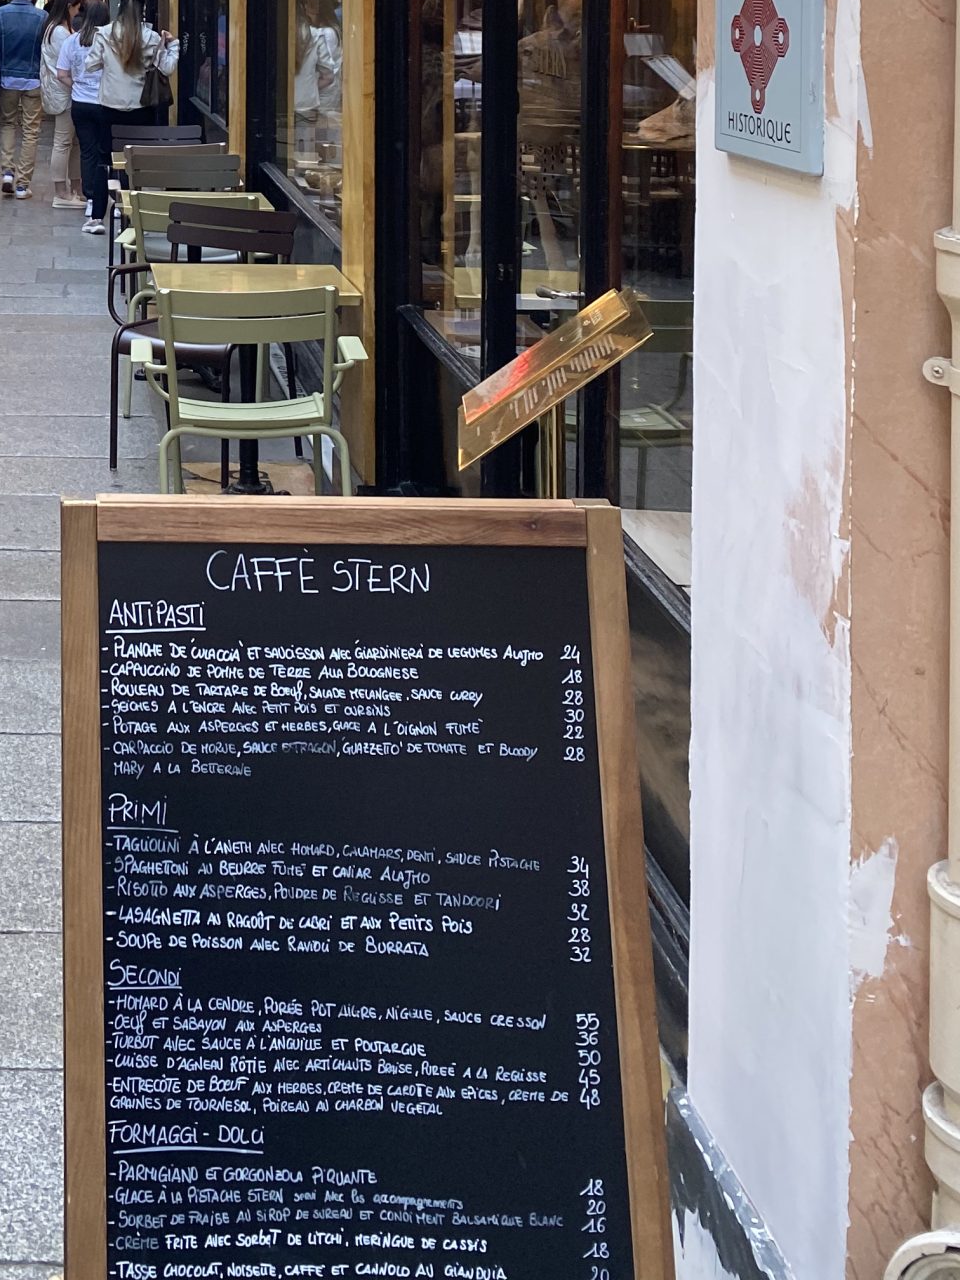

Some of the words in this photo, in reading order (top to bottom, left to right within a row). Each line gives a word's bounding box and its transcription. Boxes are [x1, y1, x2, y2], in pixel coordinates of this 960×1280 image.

[728, 111, 792, 144] HISTORIQUE
[332, 559, 429, 594] STERN
[106, 599, 206, 630] ANTIPASTI
[114, 635, 162, 658] PLANCHE
[264, 646, 325, 660] SAUCISSON
[329, 648, 351, 661] AVEC
[447, 646, 498, 659] LEGUMES
[503, 645, 543, 666] ALAJMO
[560, 645, 580, 664] 24
[110, 661, 180, 677] CAPPUCCINO
[207, 664, 244, 679] POMME
[269, 664, 311, 679] TERRE
[347, 662, 419, 679] BOLOGNESE
[562, 669, 582, 684] 18
[112, 677, 164, 697] ROULEAU
[195, 683, 248, 697] TARTARE
[309, 686, 346, 699] SALADE
[411, 688, 442, 700] SAUCE
[450, 690, 483, 708] CURRY
[562, 690, 583, 705] 28
[232, 702, 257, 714] AVEC
[262, 700, 291, 714] PETIT
[294, 703, 317, 713] POIS
[344, 704, 391, 717] OURSINS
[564, 709, 584, 723] 30
[113, 715, 157, 734] POTAGE
[198, 719, 259, 733] ASPERGES
[333, 720, 360, 732] GLACE
[563, 725, 584, 739] 22
[113, 740, 173, 755] CARPACCIO
[243, 741, 277, 753] SAUCE
[424, 742, 467, 755] TOMATE
[500, 743, 538, 762] BLOODY
[563, 746, 585, 762] 28
[114, 760, 144, 779] MARY
[109, 793, 167, 825] PRIMI
[257, 840, 285, 854] AVEC
[445, 852, 481, 865] SAUCE
[567, 856, 589, 879] 34
[219, 860, 266, 876] BEURRE
[333, 865, 372, 879] CAVIAR
[380, 866, 430, 889] ALAJMO
[568, 880, 590, 896] 38
[274, 882, 318, 900] POUDRE
[567, 903, 590, 921] 32
[119, 905, 200, 926] LASAGNETTA
[299, 915, 332, 931] CABRI
[389, 911, 433, 932] PETITS
[442, 915, 472, 934] POIS
[568, 927, 591, 943] 28
[116, 930, 162, 949] SOUPE
[192, 933, 242, 950] POISSON
[250, 937, 280, 951] AVEC
[288, 935, 330, 952] RAVIOLI
[365, 935, 429, 957] BURRATA
[570, 946, 591, 962] 32
[108, 959, 182, 989] SECONDI
[116, 997, 168, 1011] HOMARD
[311, 1000, 336, 1017] POT
[444, 1010, 481, 1023] SAUCE
[576, 1013, 599, 1030] 55
[173, 1016, 226, 1036] SABAYON
[262, 1019, 322, 1034] ASPERGES
[575, 1031, 598, 1046] 36
[112, 1032, 159, 1048] TURBOT
[163, 1035, 195, 1051] AVEC
[202, 1037, 241, 1050] SAUCE
[578, 1049, 601, 1066] 50
[115, 1052, 158, 1068] CUISSE
[273, 1057, 299, 1072] AVEC
[305, 1055, 372, 1072] ARTICHAUTS
[579, 1069, 600, 1085] 45
[111, 1095, 161, 1110] GRAINES
[263, 1097, 309, 1113] POIREAU
[579, 1085, 600, 1110] 48
[109, 1120, 198, 1145] FORMAGGI
[218, 1125, 264, 1144] DOLCI
[116, 1187, 154, 1205] GLACE
[248, 1188, 283, 1203] STERN
[586, 1199, 606, 1215] 20
[580, 1178, 604, 1196] 18
[256, 1207, 291, 1222] SIROP
[581, 1217, 606, 1233] 16
[165, 1234, 198, 1250] FRITE
[204, 1234, 231, 1248] AVEC
[355, 1231, 415, 1249] MERINGUE
[583, 1242, 609, 1258] 18
[116, 1261, 157, 1280] TASSE
[355, 1262, 410, 1277] CANNOLO
